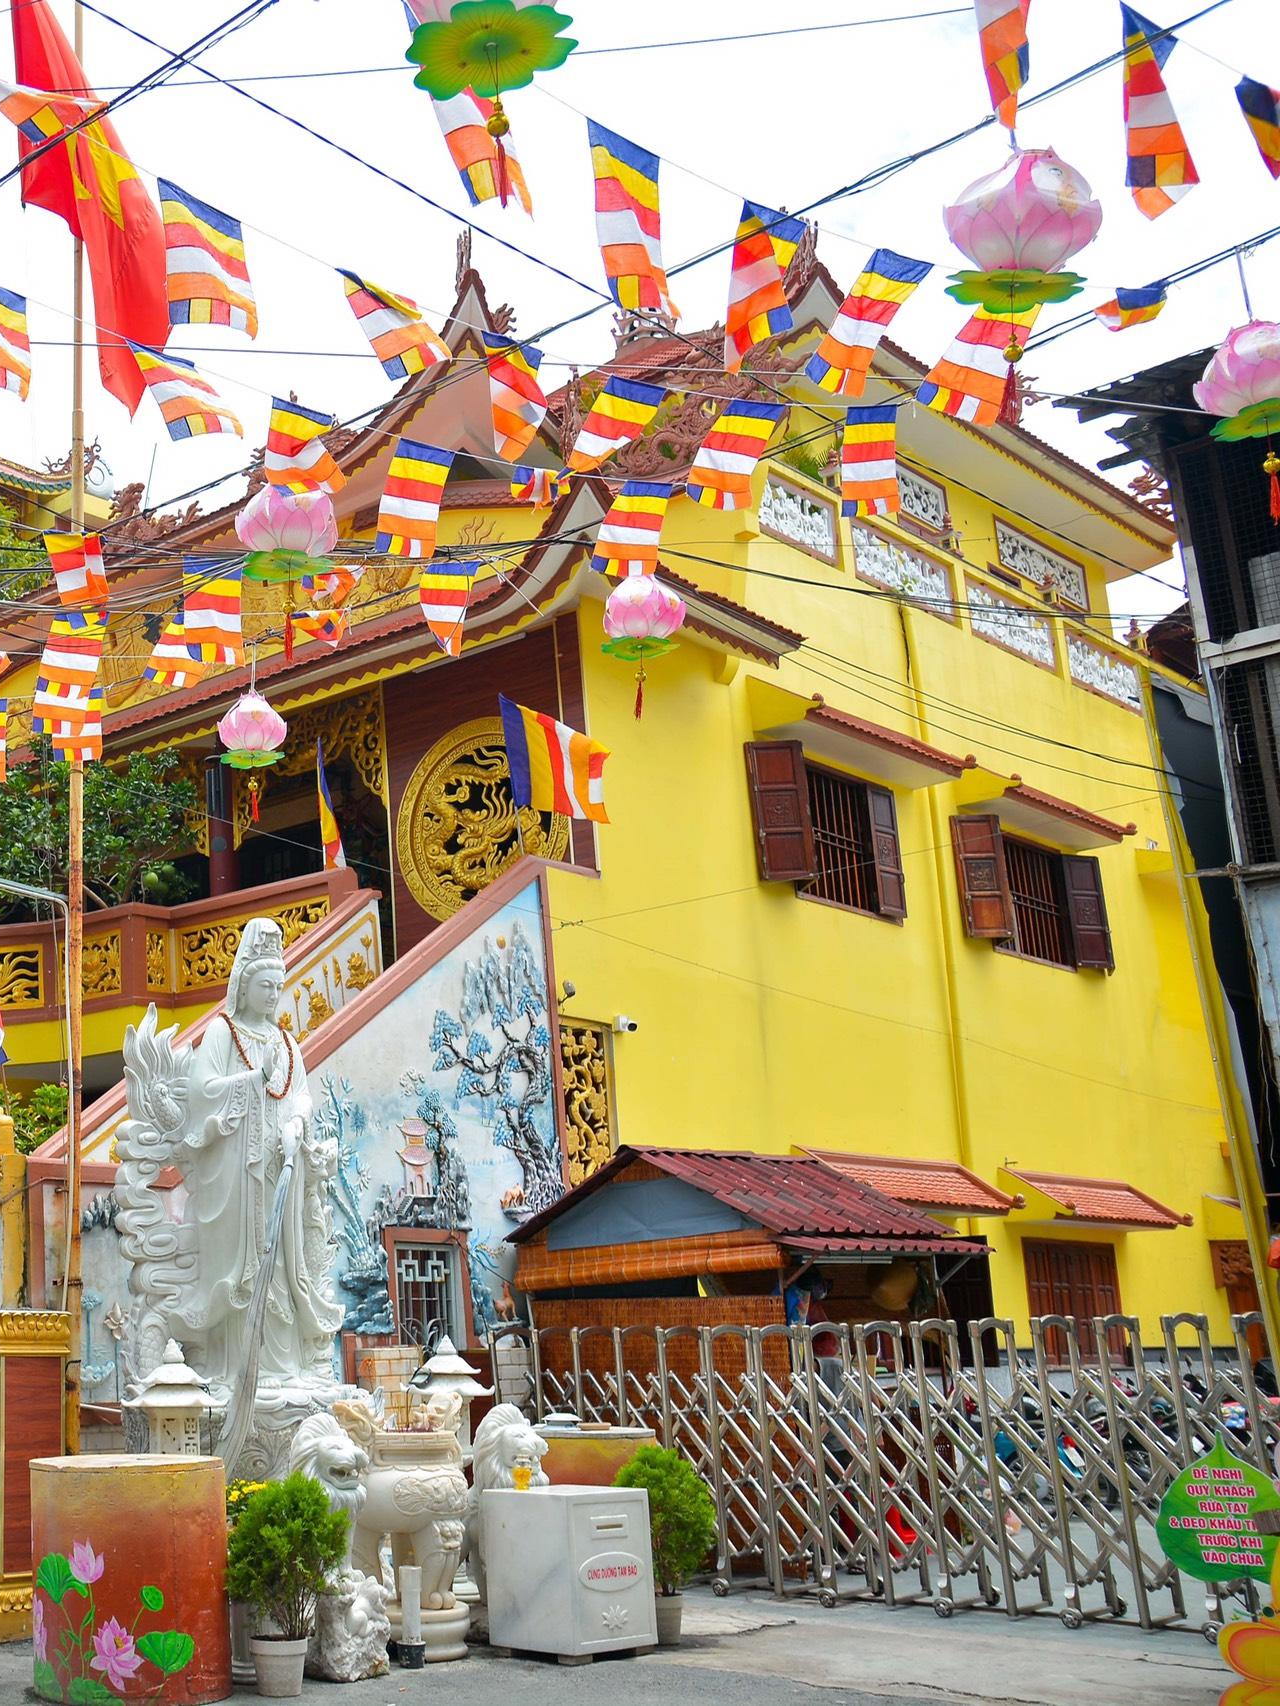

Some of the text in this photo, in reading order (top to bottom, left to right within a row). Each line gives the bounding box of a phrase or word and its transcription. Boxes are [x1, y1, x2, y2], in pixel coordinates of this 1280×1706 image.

[1212, 1469, 1243, 1482] NGHỊ
[1214, 1485, 1255, 1497] KHÁCH
[1226, 1503, 1248, 1513] TAY
[1170, 1518, 1179, 1527] &
[1182, 1518, 1206, 1529] ĐEO
[1240, 1537, 1262, 1548] KHI
[1203, 1550, 1264, 1566] VÀO CHÙA
